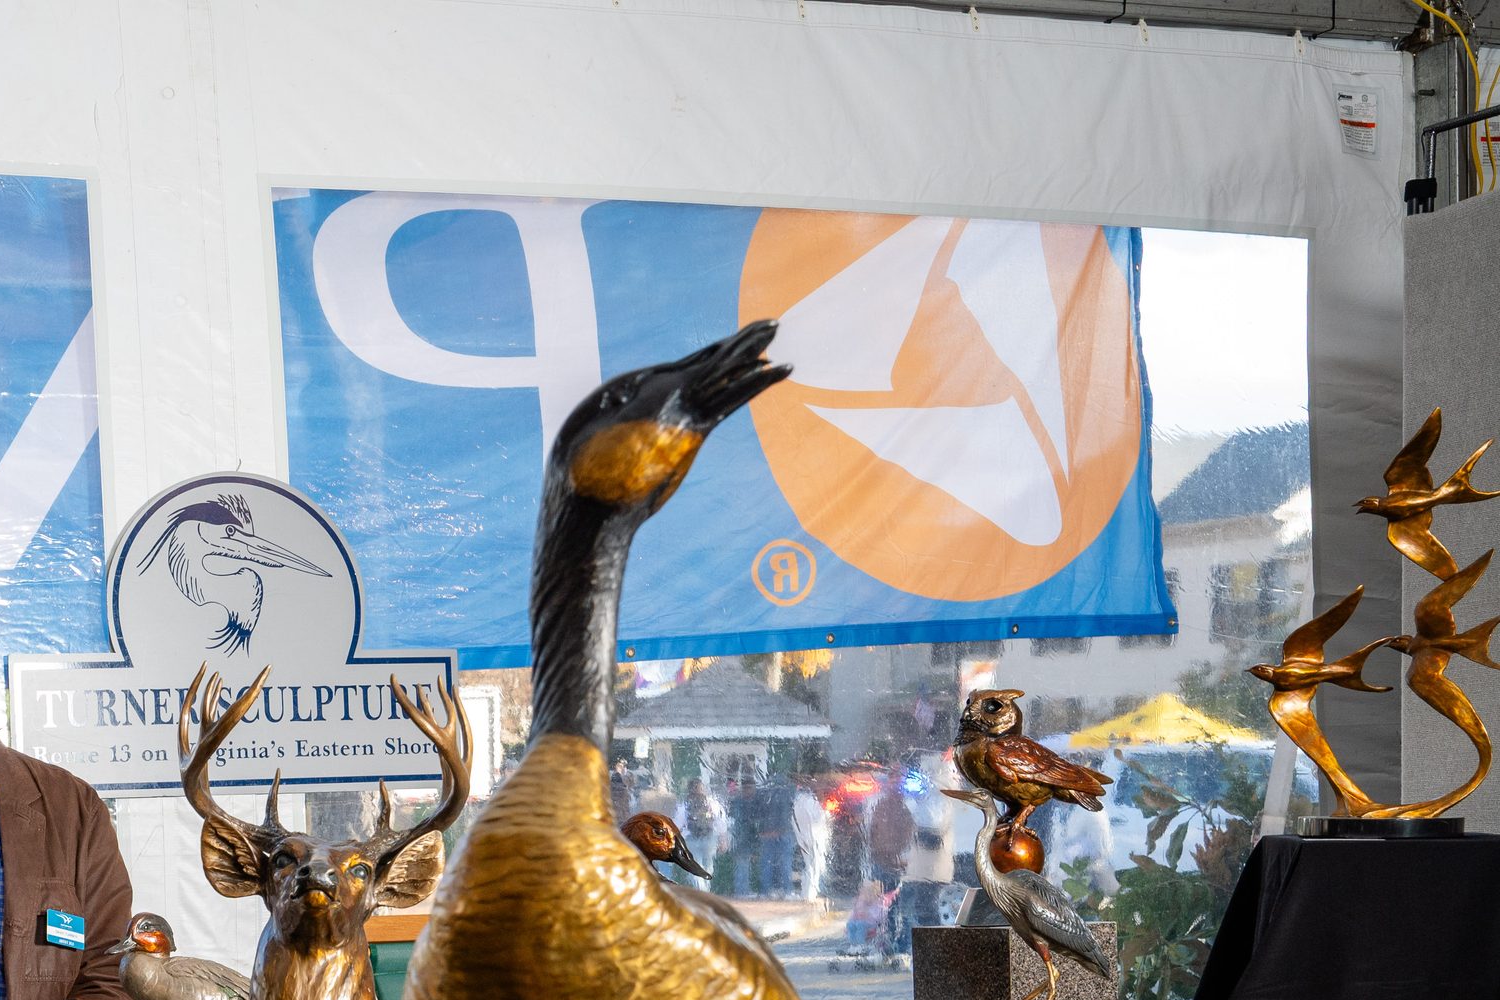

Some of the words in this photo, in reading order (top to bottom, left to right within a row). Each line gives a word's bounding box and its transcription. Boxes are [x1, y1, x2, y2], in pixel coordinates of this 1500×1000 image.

[36, 687, 200, 729] TURNER
[109, 744, 132, 763] 13
[141, 749, 168, 763] on
[190, 740, 285, 767] ginia's
[294, 739, 375, 757] Eastern
